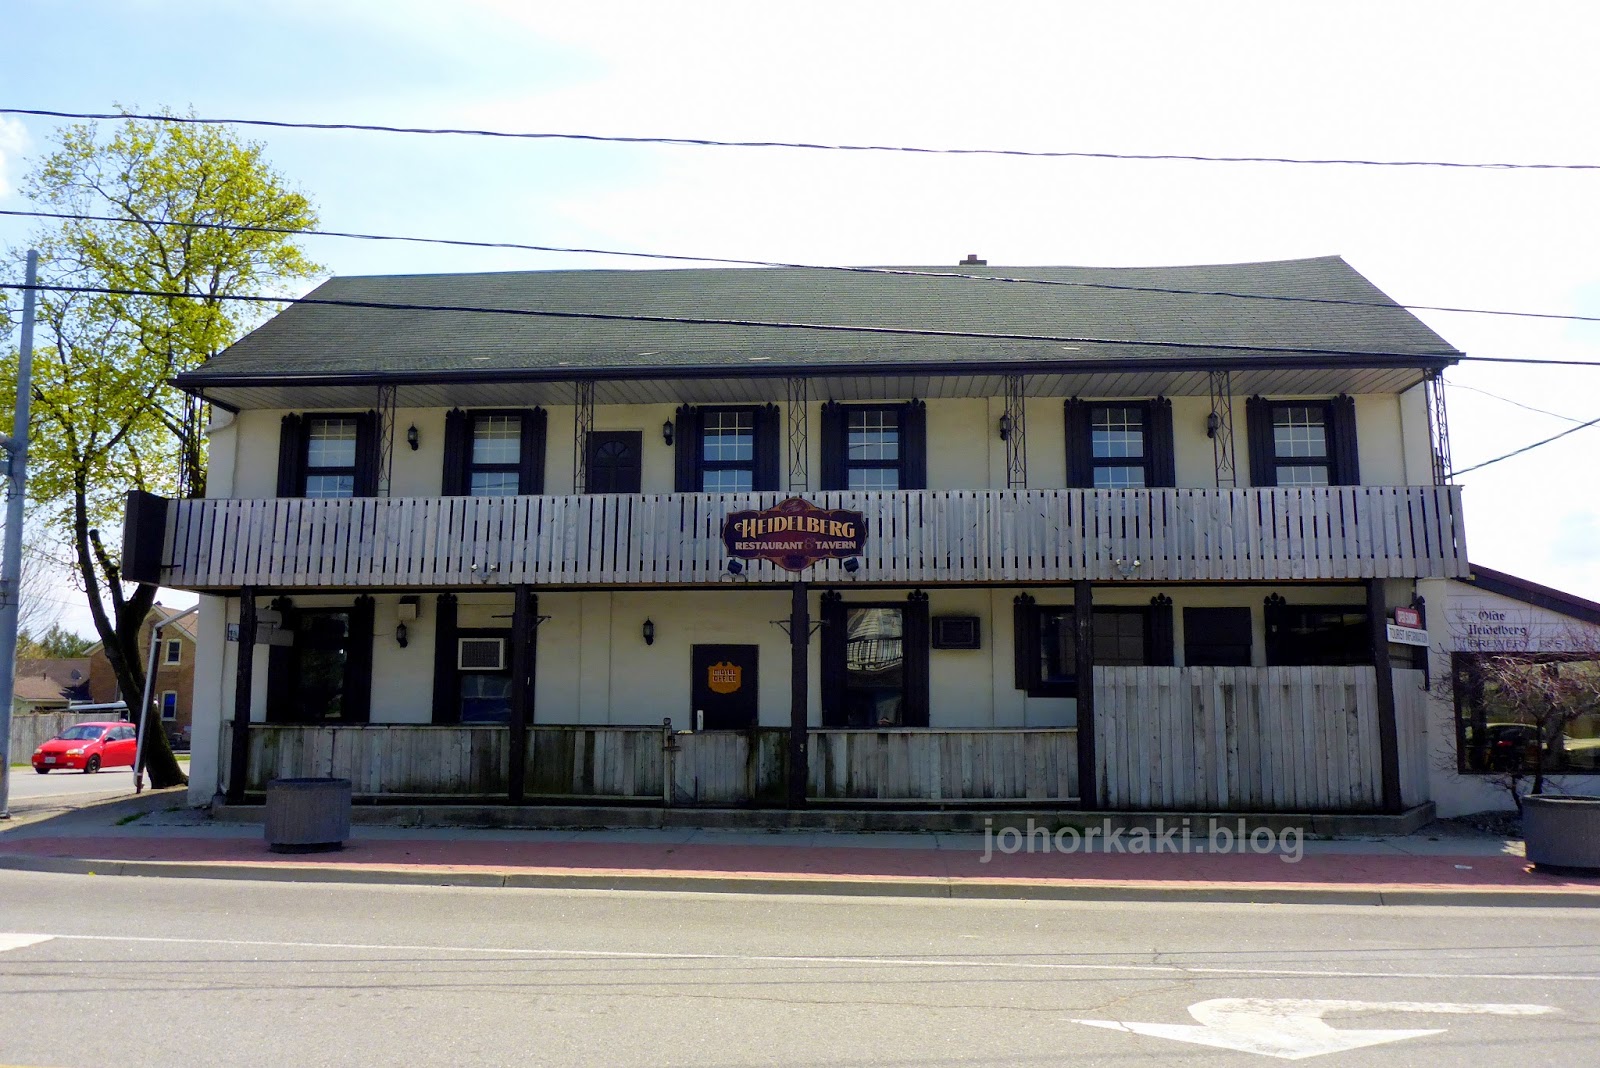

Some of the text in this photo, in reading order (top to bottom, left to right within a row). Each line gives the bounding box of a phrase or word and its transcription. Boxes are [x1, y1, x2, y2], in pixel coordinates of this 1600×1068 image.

[734, 516, 856, 539] HEIDELBERG
[735, 541, 803, 550] RESTAURANT
[816, 540, 857, 549] TAVERN
[1478, 610, 1505, 621] Olde
[1468, 624, 1527, 636] Heidelberg
[712, 675, 736, 683] OFFICE
